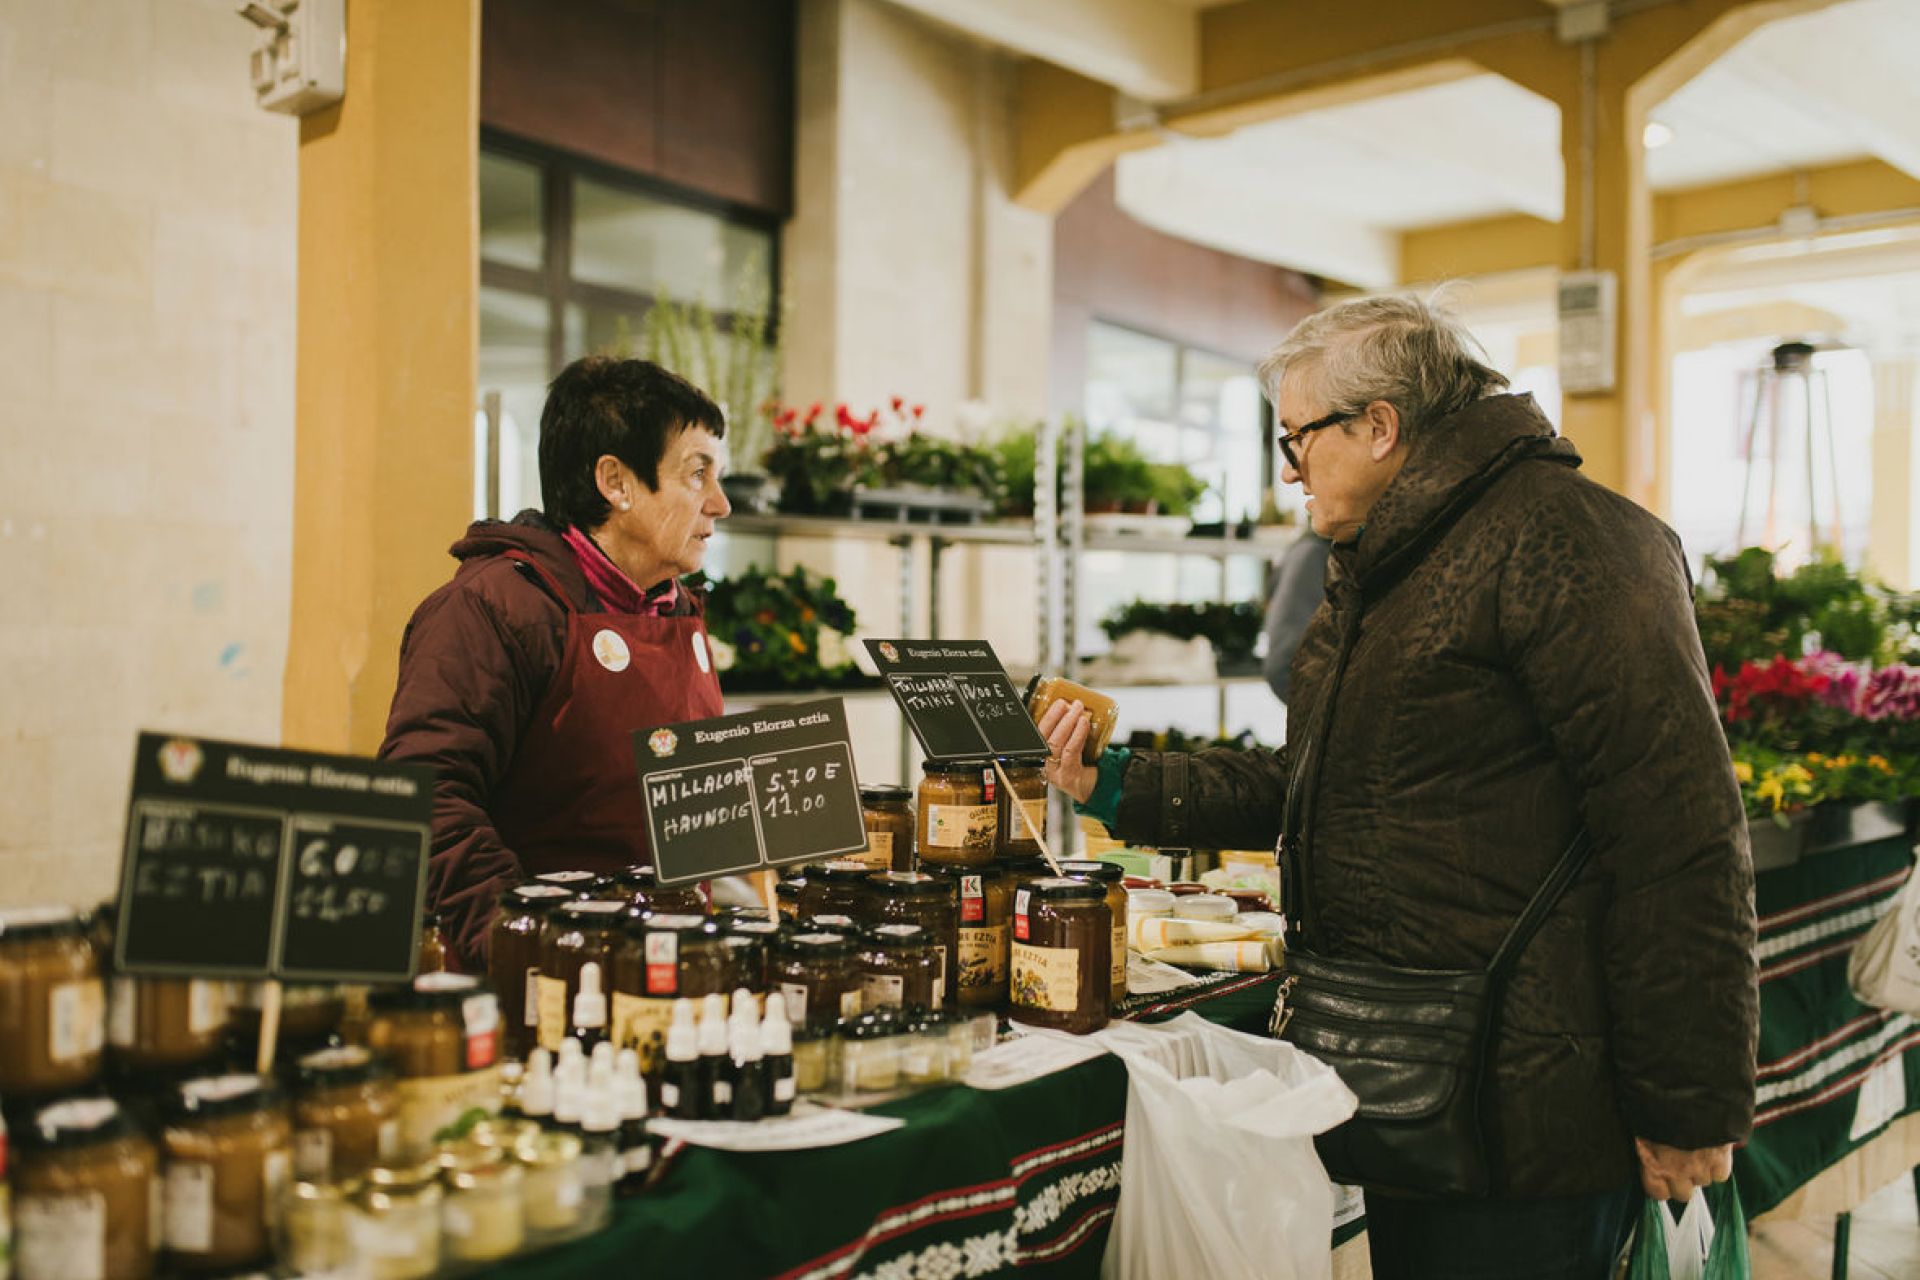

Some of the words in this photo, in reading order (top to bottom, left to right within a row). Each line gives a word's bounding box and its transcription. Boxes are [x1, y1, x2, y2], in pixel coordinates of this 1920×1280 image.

[694, 724, 751, 744] Eugenio
[752, 717, 797, 734] Elorza
[798, 711, 830, 727] eztia
